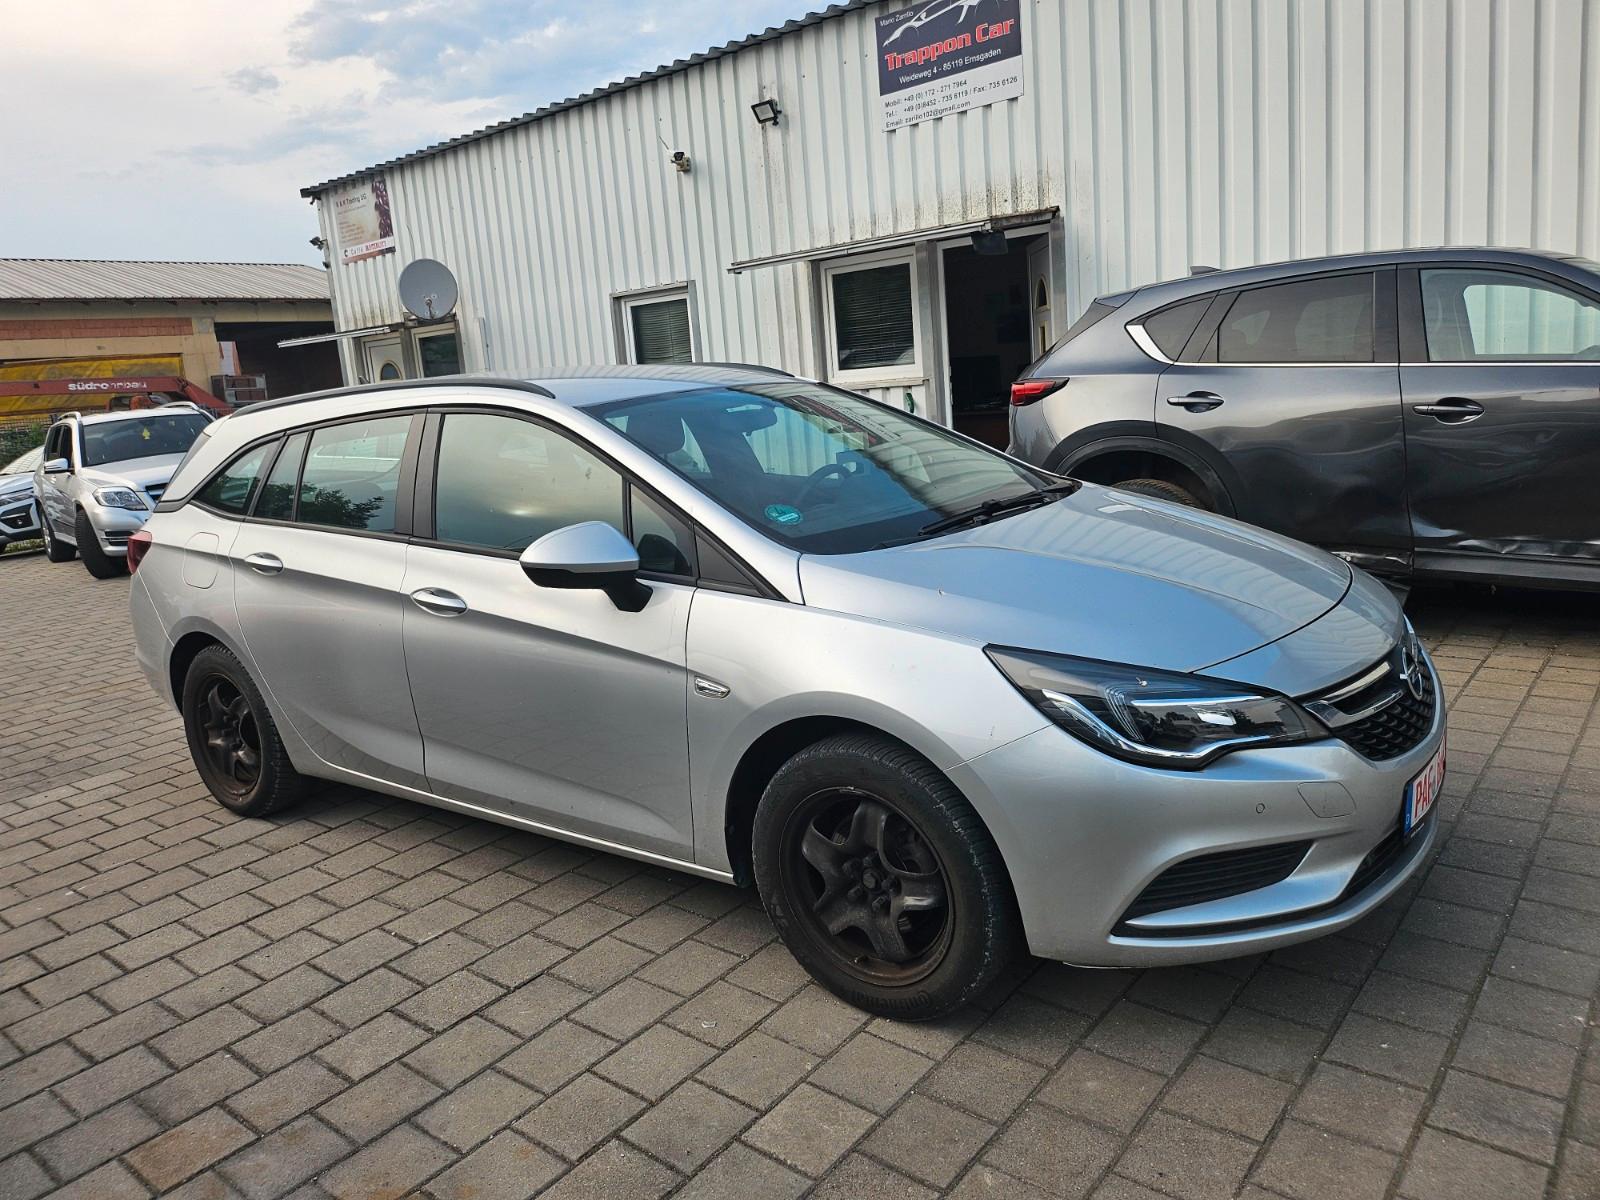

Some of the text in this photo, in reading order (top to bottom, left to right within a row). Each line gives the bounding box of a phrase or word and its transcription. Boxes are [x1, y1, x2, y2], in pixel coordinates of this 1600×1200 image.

[884, 19, 1015, 71] Trappon Car
[899, 69, 932, 85] Weideweg
[932, 66, 938, 74] 4
[943, 58, 964, 71] 85119
[988, 80, 1000, 90] 735
[1001, 75, 1018, 86] 6126
[904, 94, 914, 102] +49
[925, 88, 935, 97] 172
[885, 118, 904, 128] Email:
